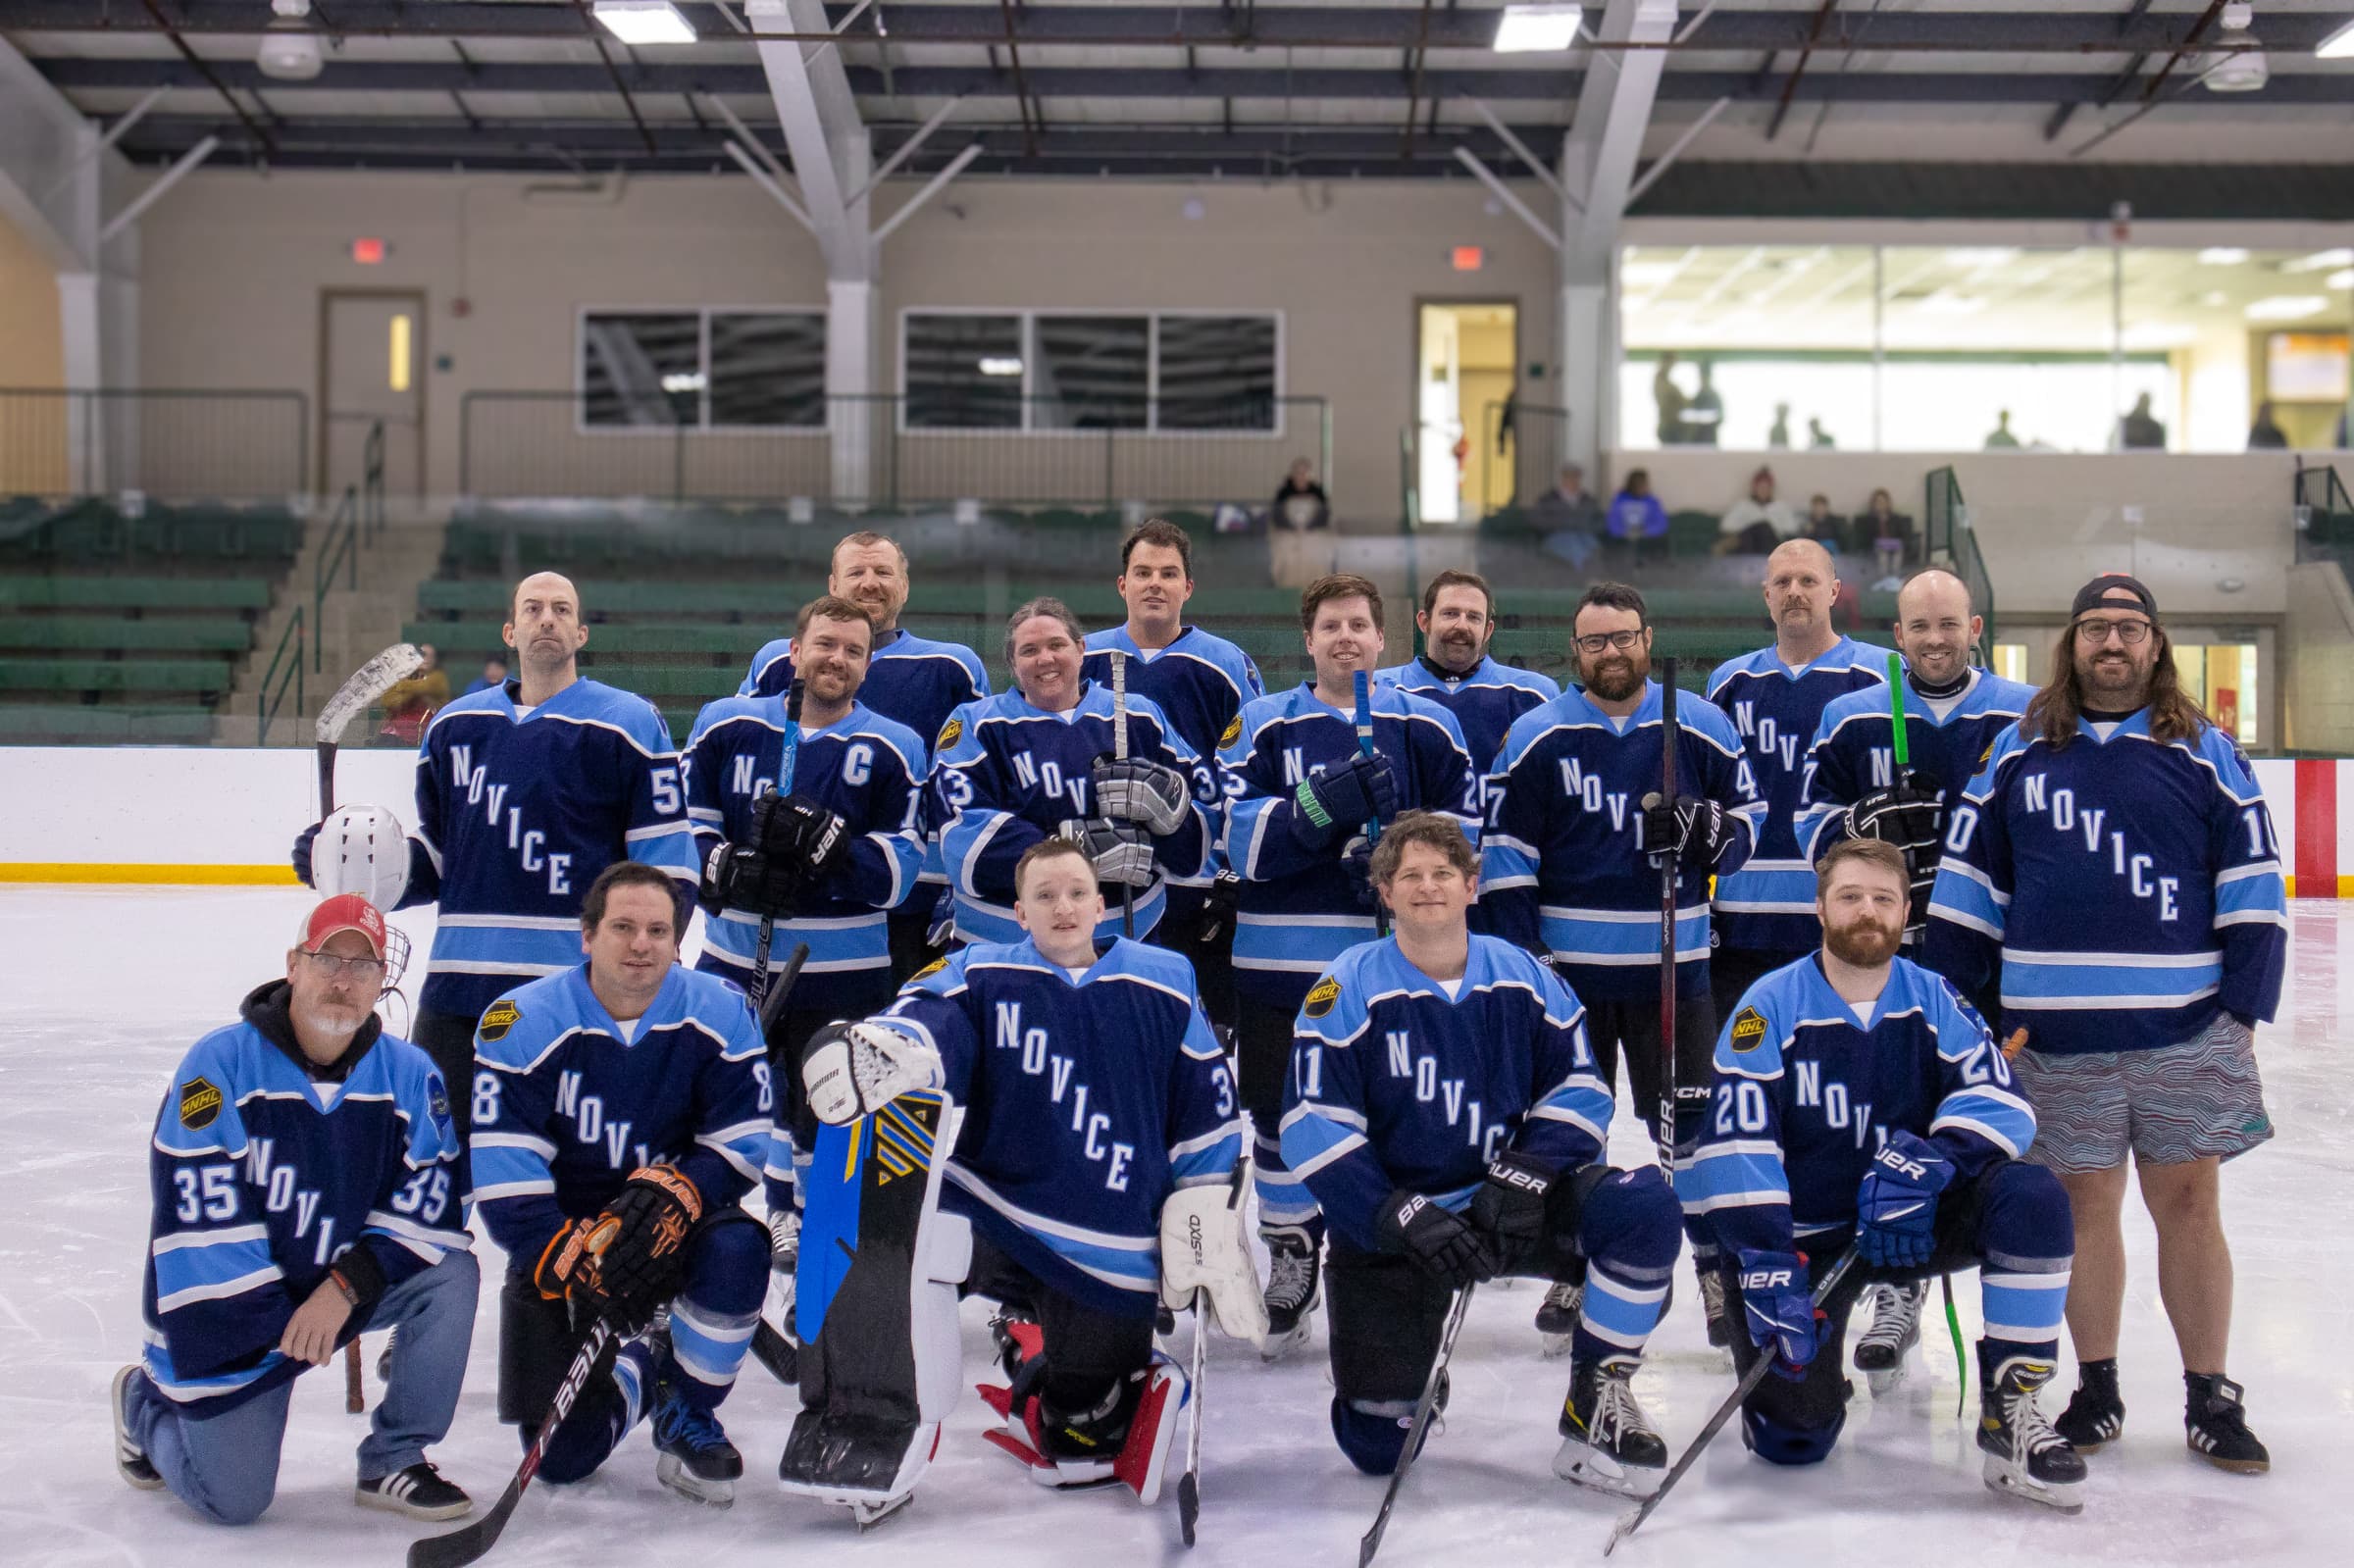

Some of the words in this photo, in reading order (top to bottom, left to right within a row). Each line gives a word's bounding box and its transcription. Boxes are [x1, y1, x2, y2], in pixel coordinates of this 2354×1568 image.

[844, 742, 875, 787] C
[1735, 701, 1808, 772] NOV
[1012, 750, 1088, 816] NOV
[450, 744, 571, 896] NOVICE
[2024, 773, 2179, 922] NOVICE
[472, 1071, 502, 1126] 8
[997, 1000, 1136, 1193] NOVICE
[1385, 1031, 1516, 1165] NOVIC
[1673, 1087, 1712, 1099] CM
[1714, 1082, 1767, 1136] 20
[173, 1164, 239, 1224] 35
[391, 1170, 451, 1224] 35
